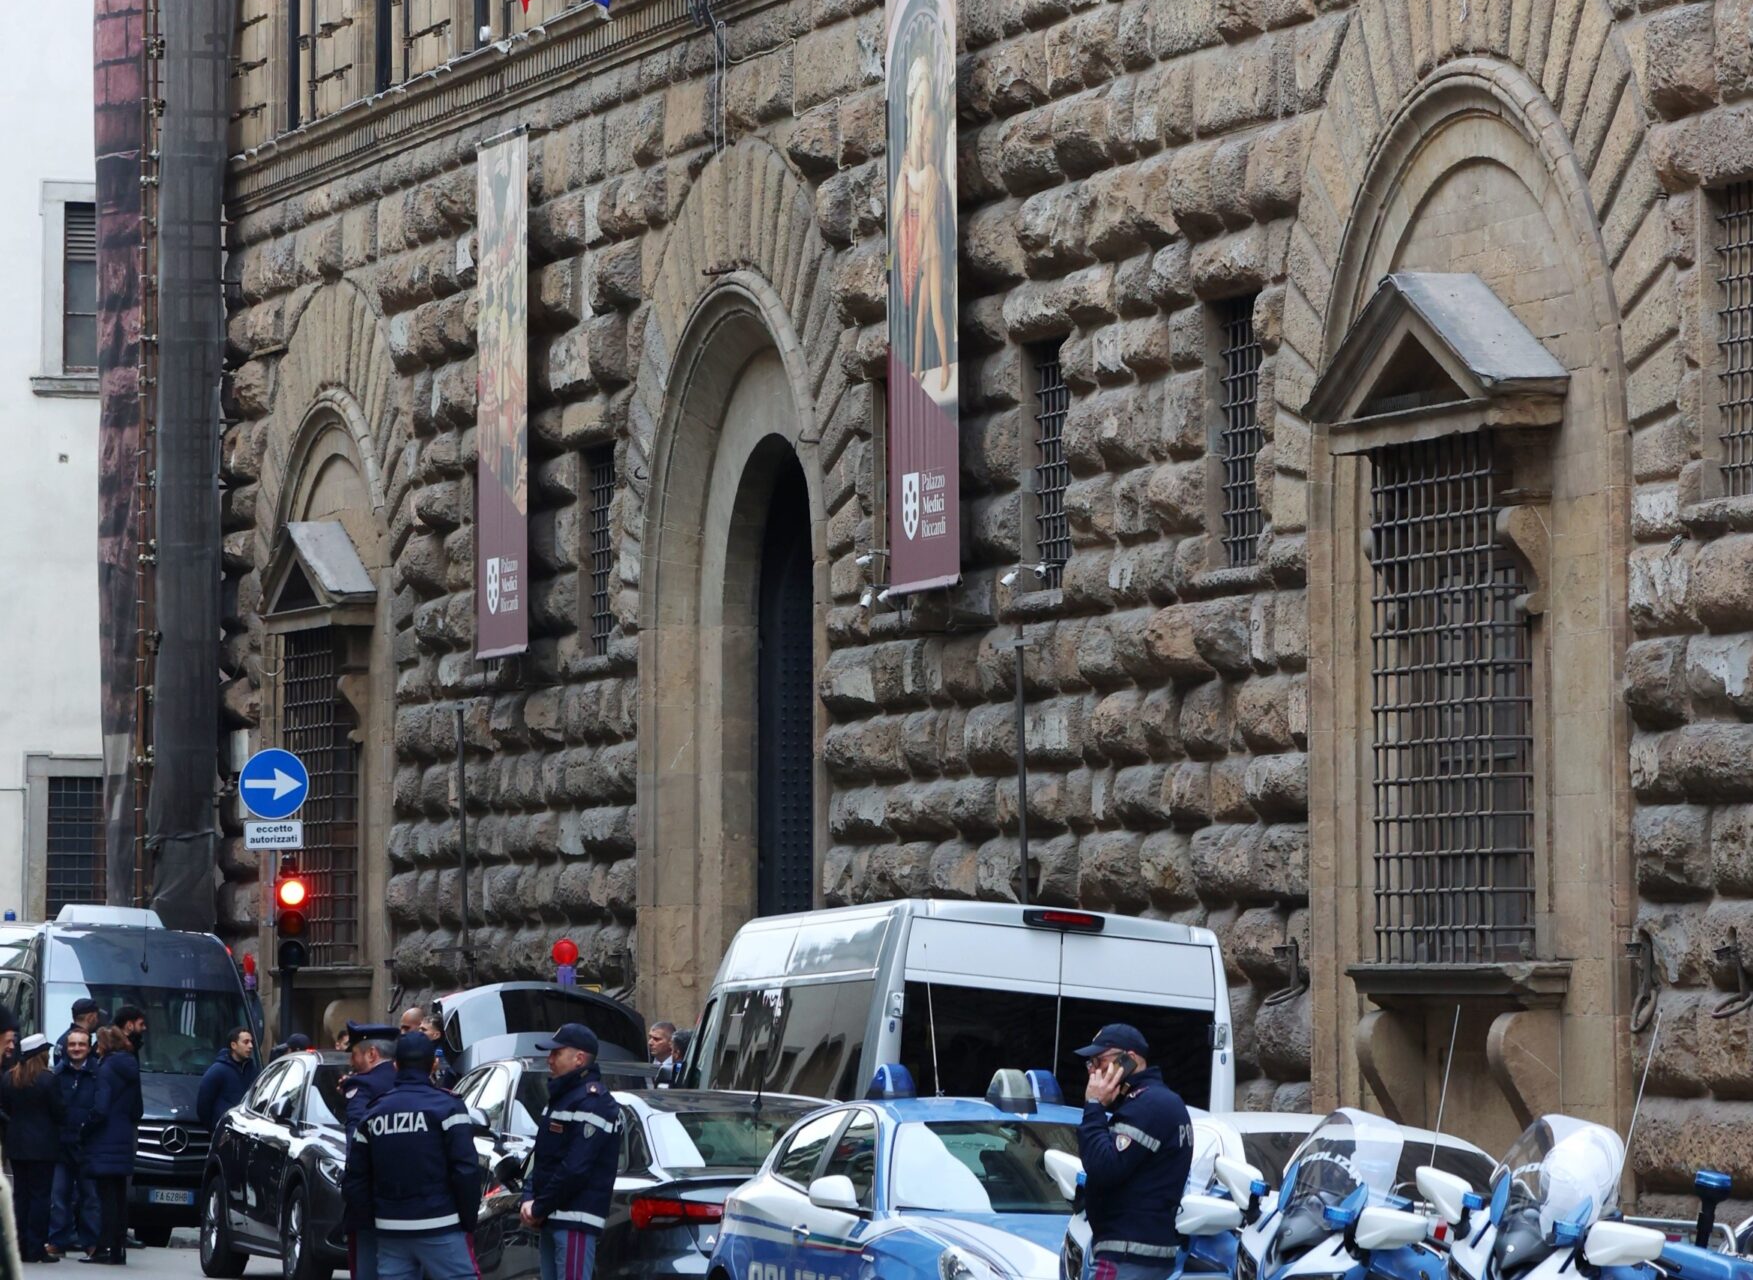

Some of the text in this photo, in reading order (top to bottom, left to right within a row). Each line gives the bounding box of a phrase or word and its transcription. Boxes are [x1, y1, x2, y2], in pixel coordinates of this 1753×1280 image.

[921, 472, 945, 491] Palazzo
[922, 493, 945, 514] Medici
[921, 516, 946, 538] Riccardi
[256, 825, 293, 833] eccetto
[250, 835, 298, 844] autorizzati
